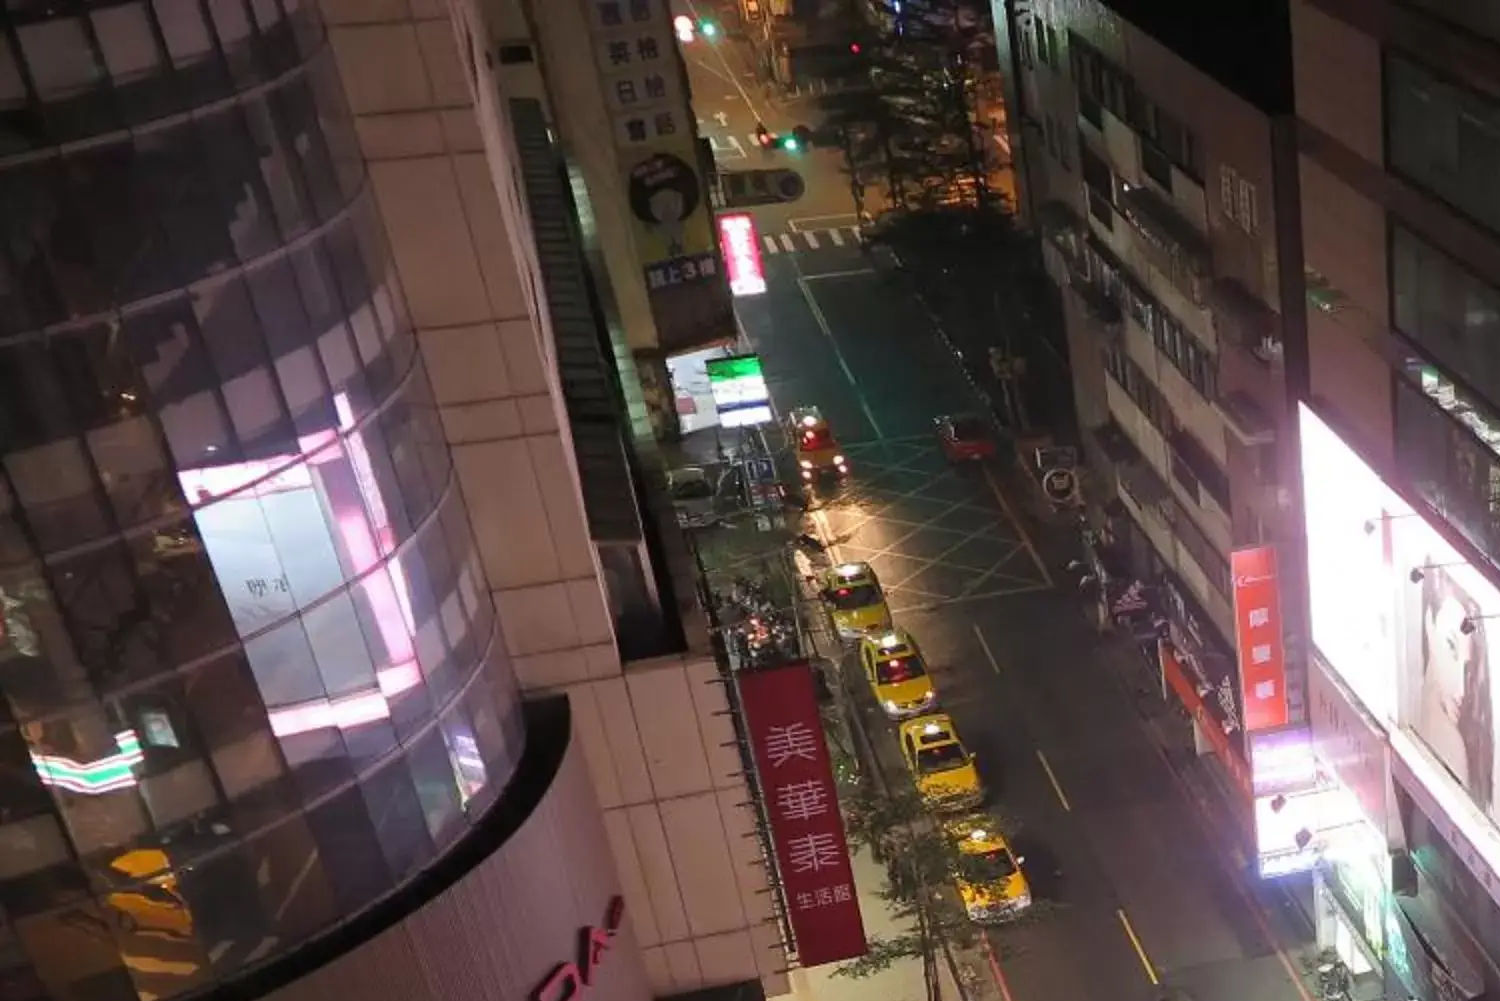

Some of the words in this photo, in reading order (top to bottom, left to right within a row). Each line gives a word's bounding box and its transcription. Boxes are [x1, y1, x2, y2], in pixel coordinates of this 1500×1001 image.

[765, 721, 841, 874] 美華泰
[796, 882, 852, 910] 生活館
